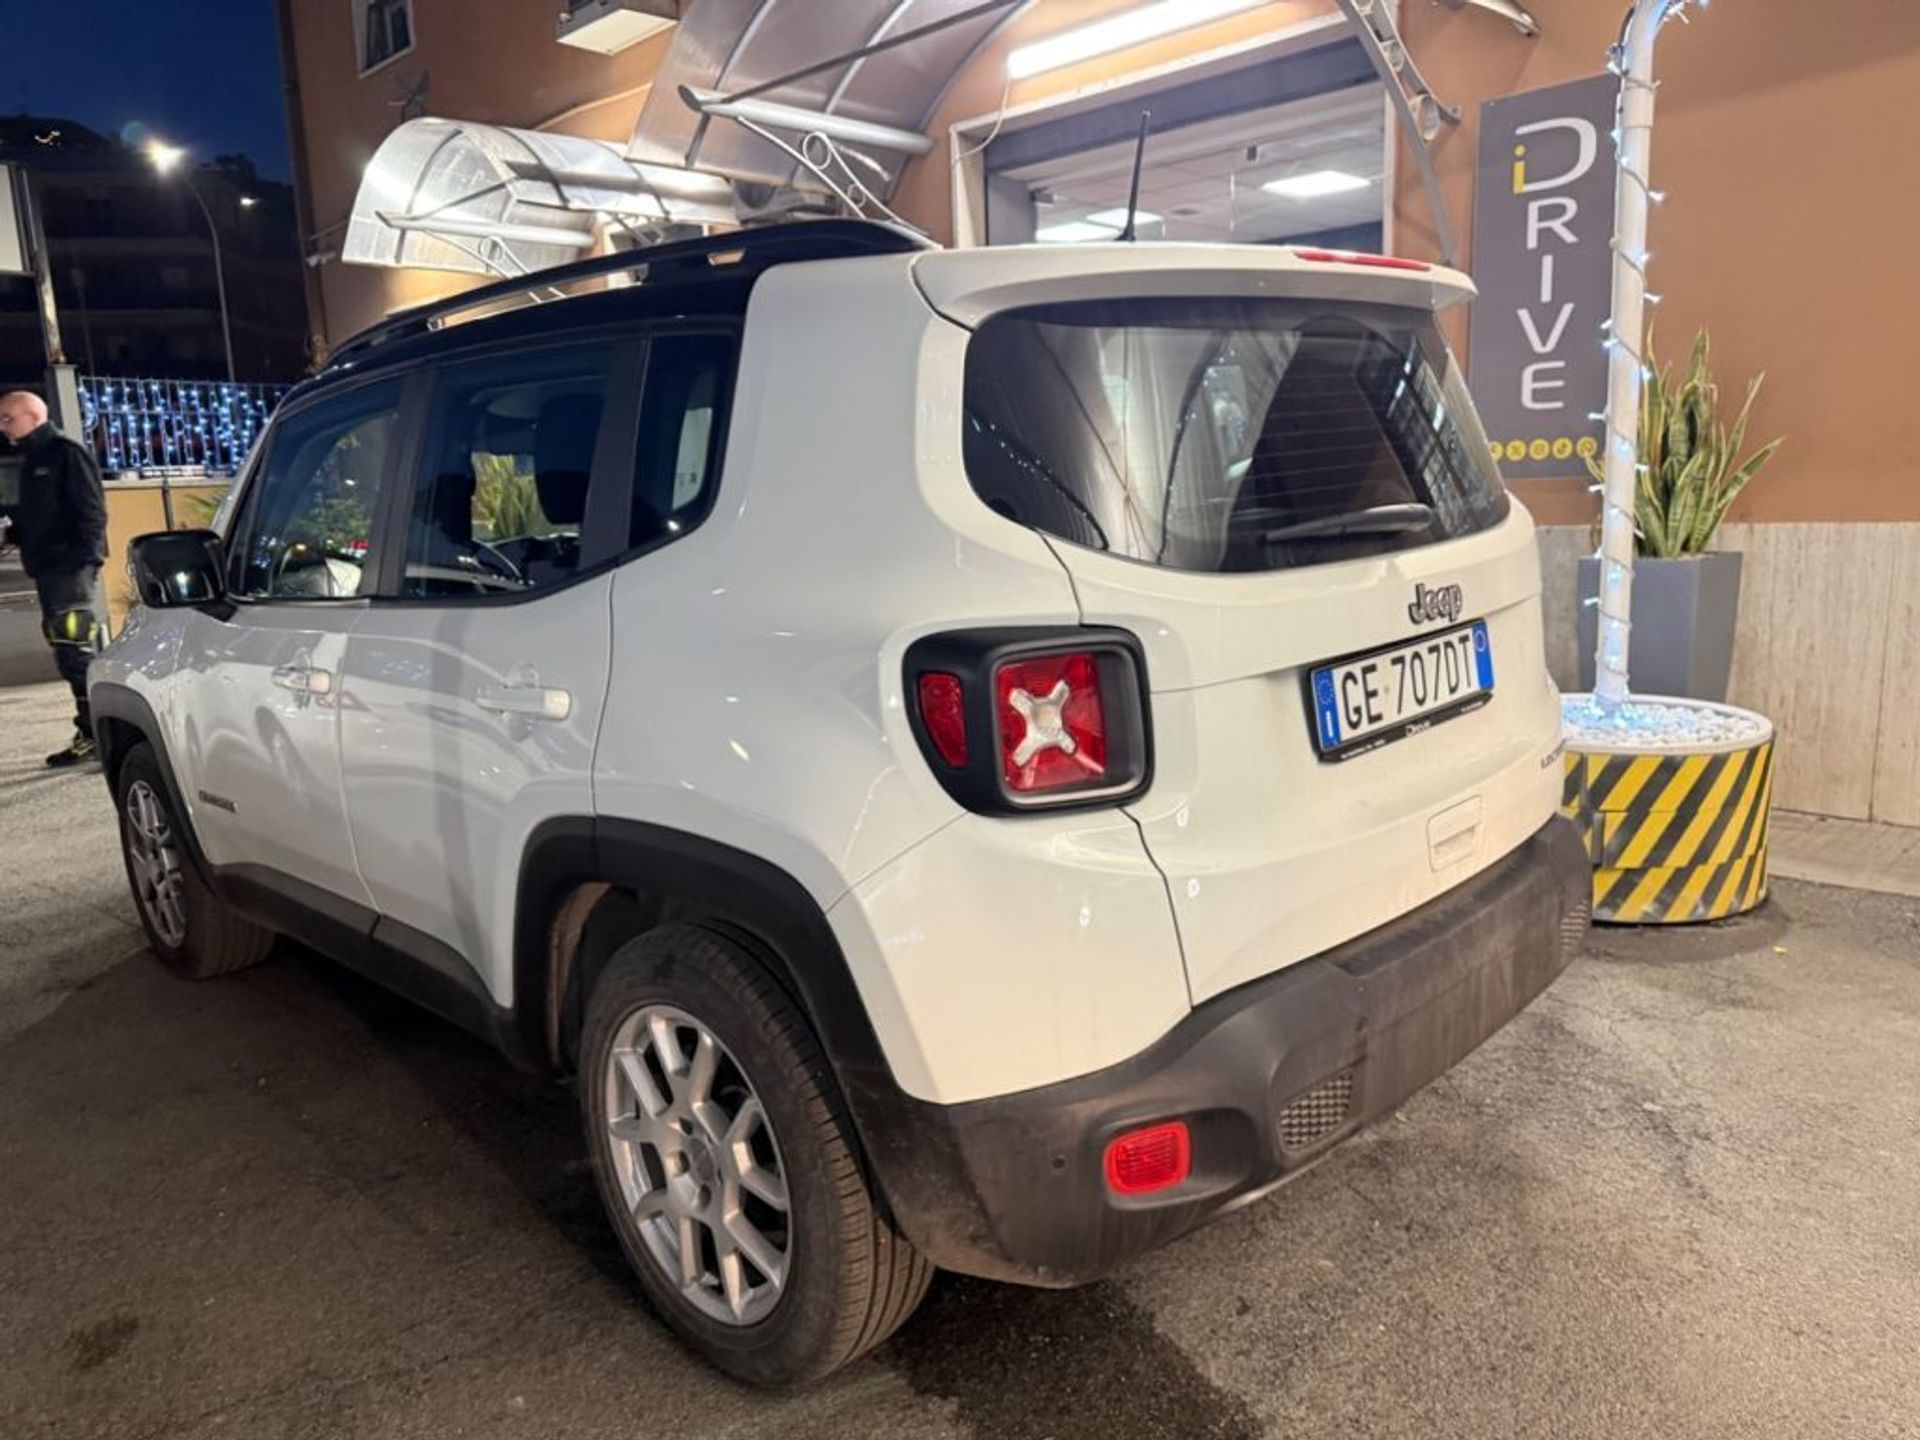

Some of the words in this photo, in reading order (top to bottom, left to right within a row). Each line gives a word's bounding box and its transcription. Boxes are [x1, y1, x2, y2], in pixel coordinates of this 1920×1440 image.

[1408, 583, 1463, 625] Jeep
[1341, 664, 1383, 730] GE
[1390, 633, 1473, 715] 707DT
